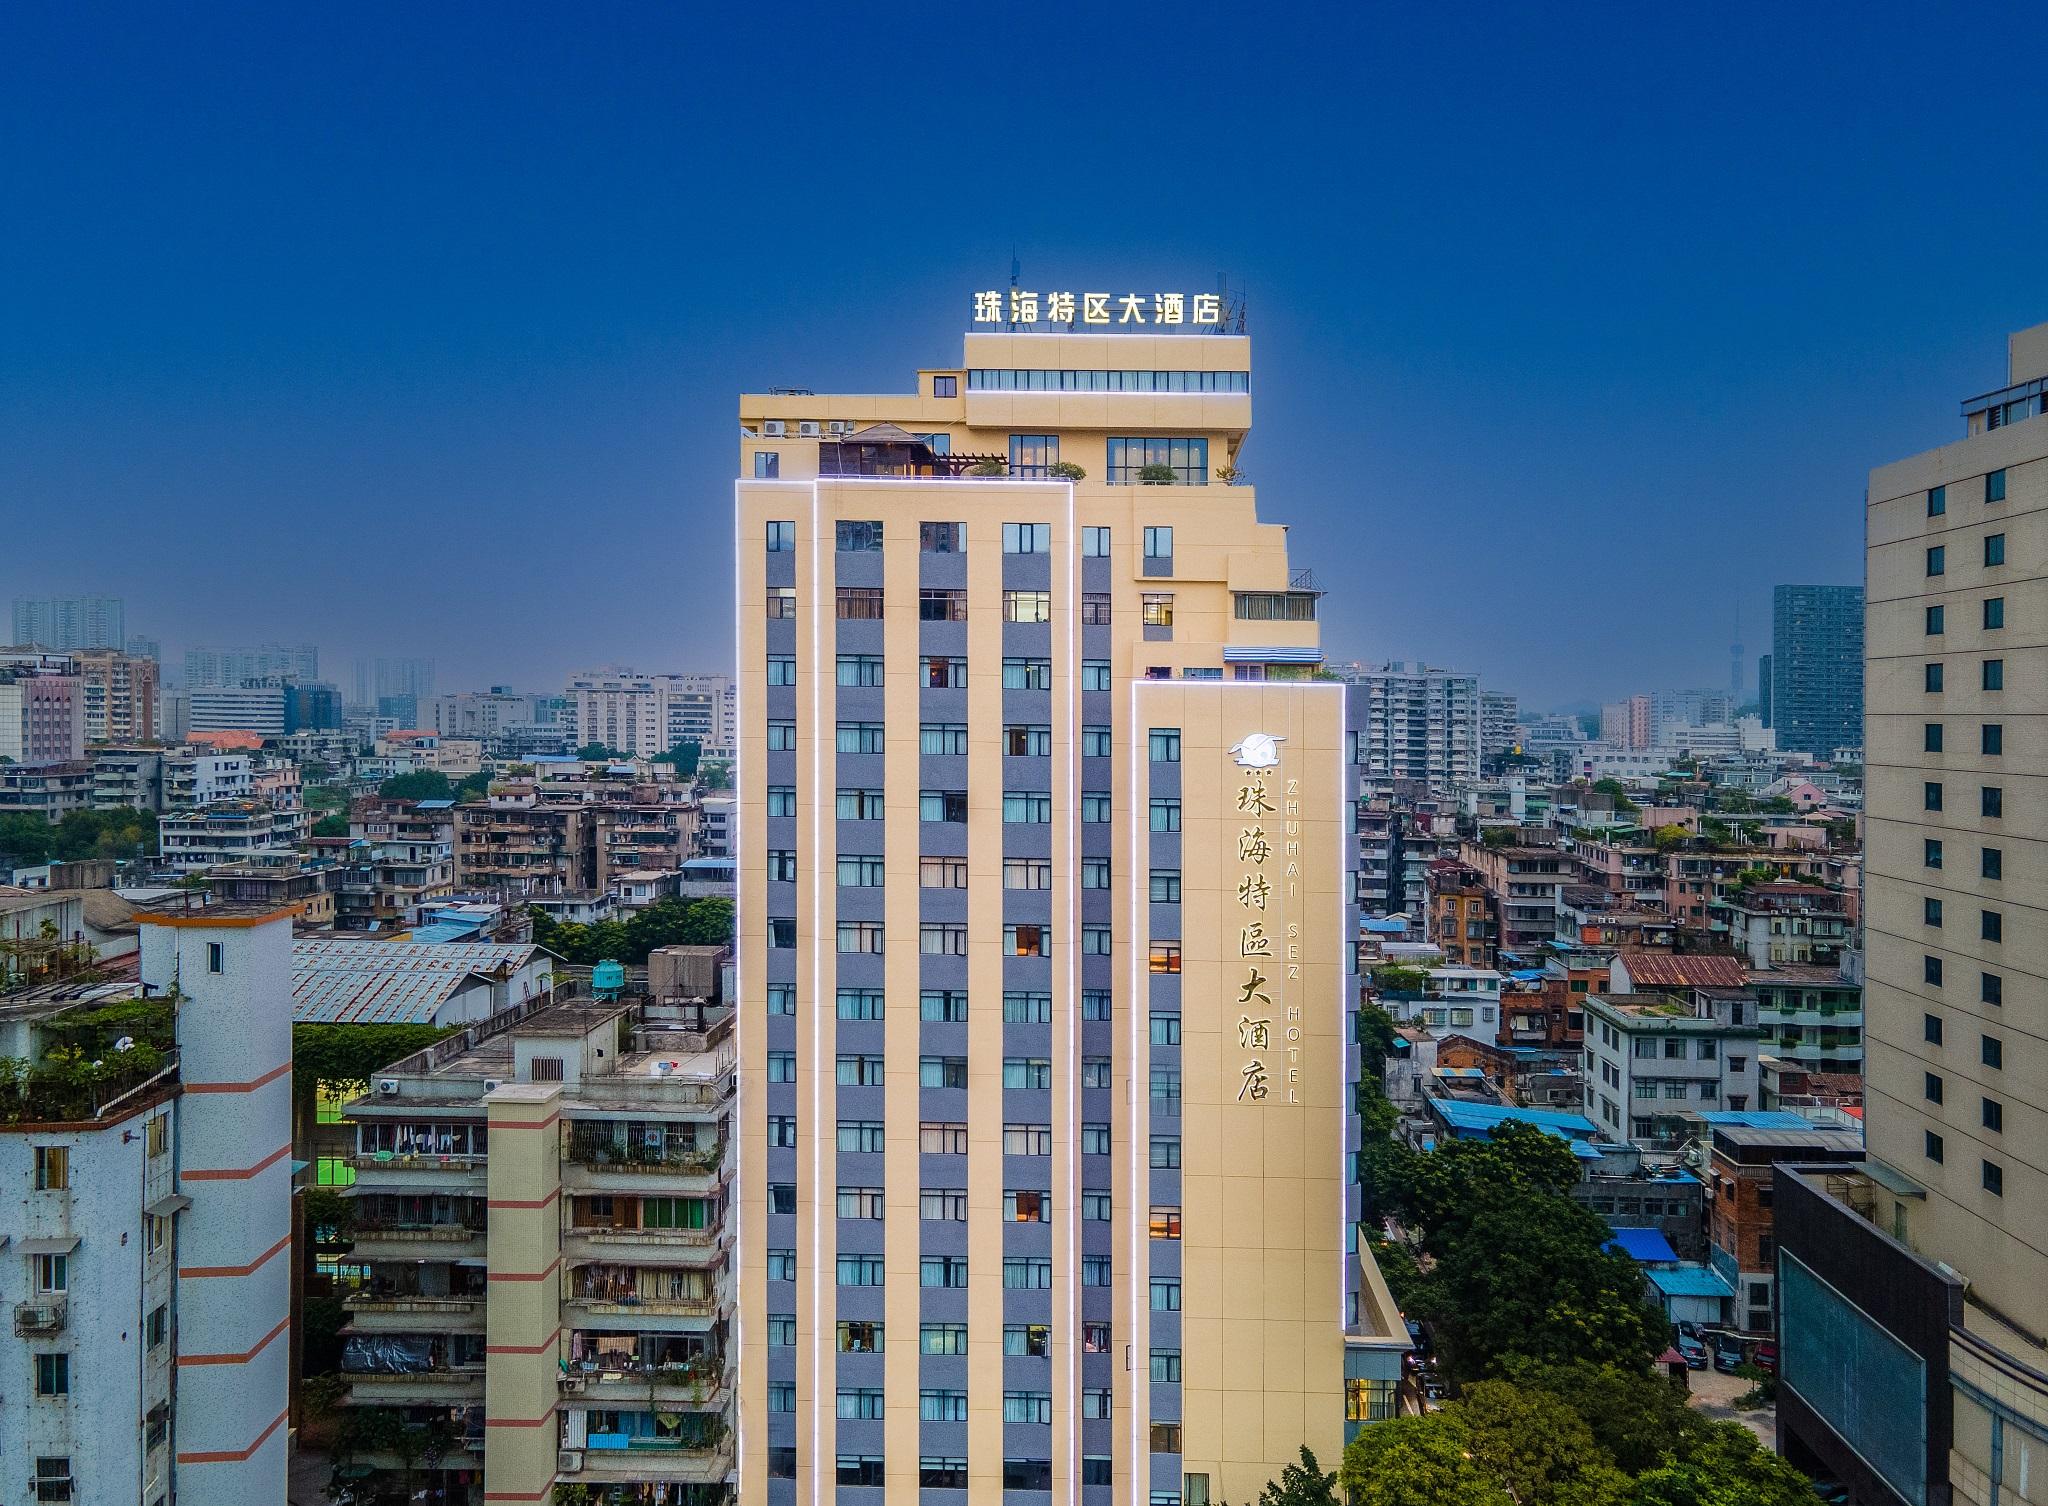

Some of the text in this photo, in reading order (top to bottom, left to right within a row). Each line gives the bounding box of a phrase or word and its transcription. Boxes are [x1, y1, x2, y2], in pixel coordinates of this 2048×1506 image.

[974, 291, 1220, 323] 珠海特区大酒店
[1237, 780, 1276, 1101] 珠海特區大酒店
[1287, 780, 1300, 1104] ZHUHAI SEZ HOTEL
